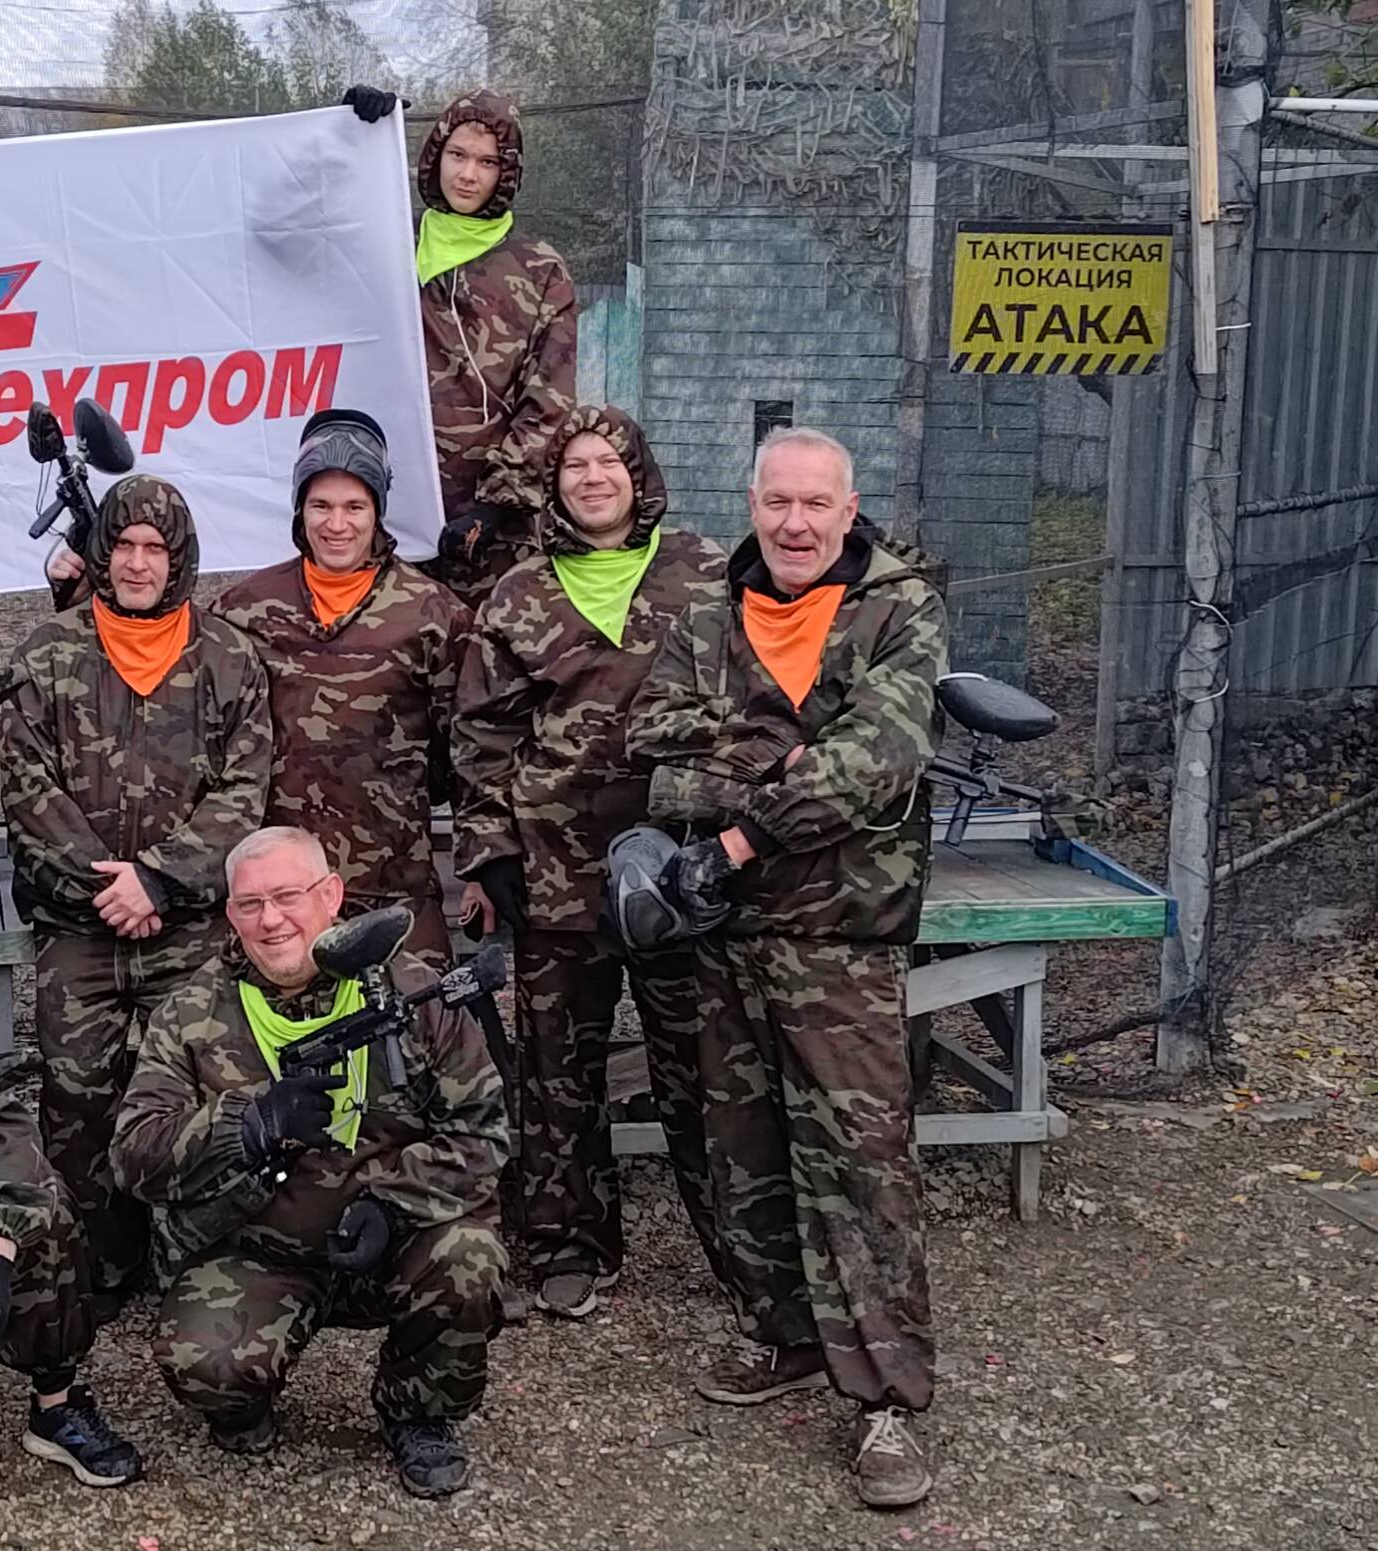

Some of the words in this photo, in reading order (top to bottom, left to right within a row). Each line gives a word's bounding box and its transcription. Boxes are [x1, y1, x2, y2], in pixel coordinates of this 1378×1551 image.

[966, 240, 1164, 263] ТАКТИЧЕСКАЯ
[994, 267, 1133, 292] ЛОКАЦИЯ
[962, 302, 1154, 345] АТАКА
